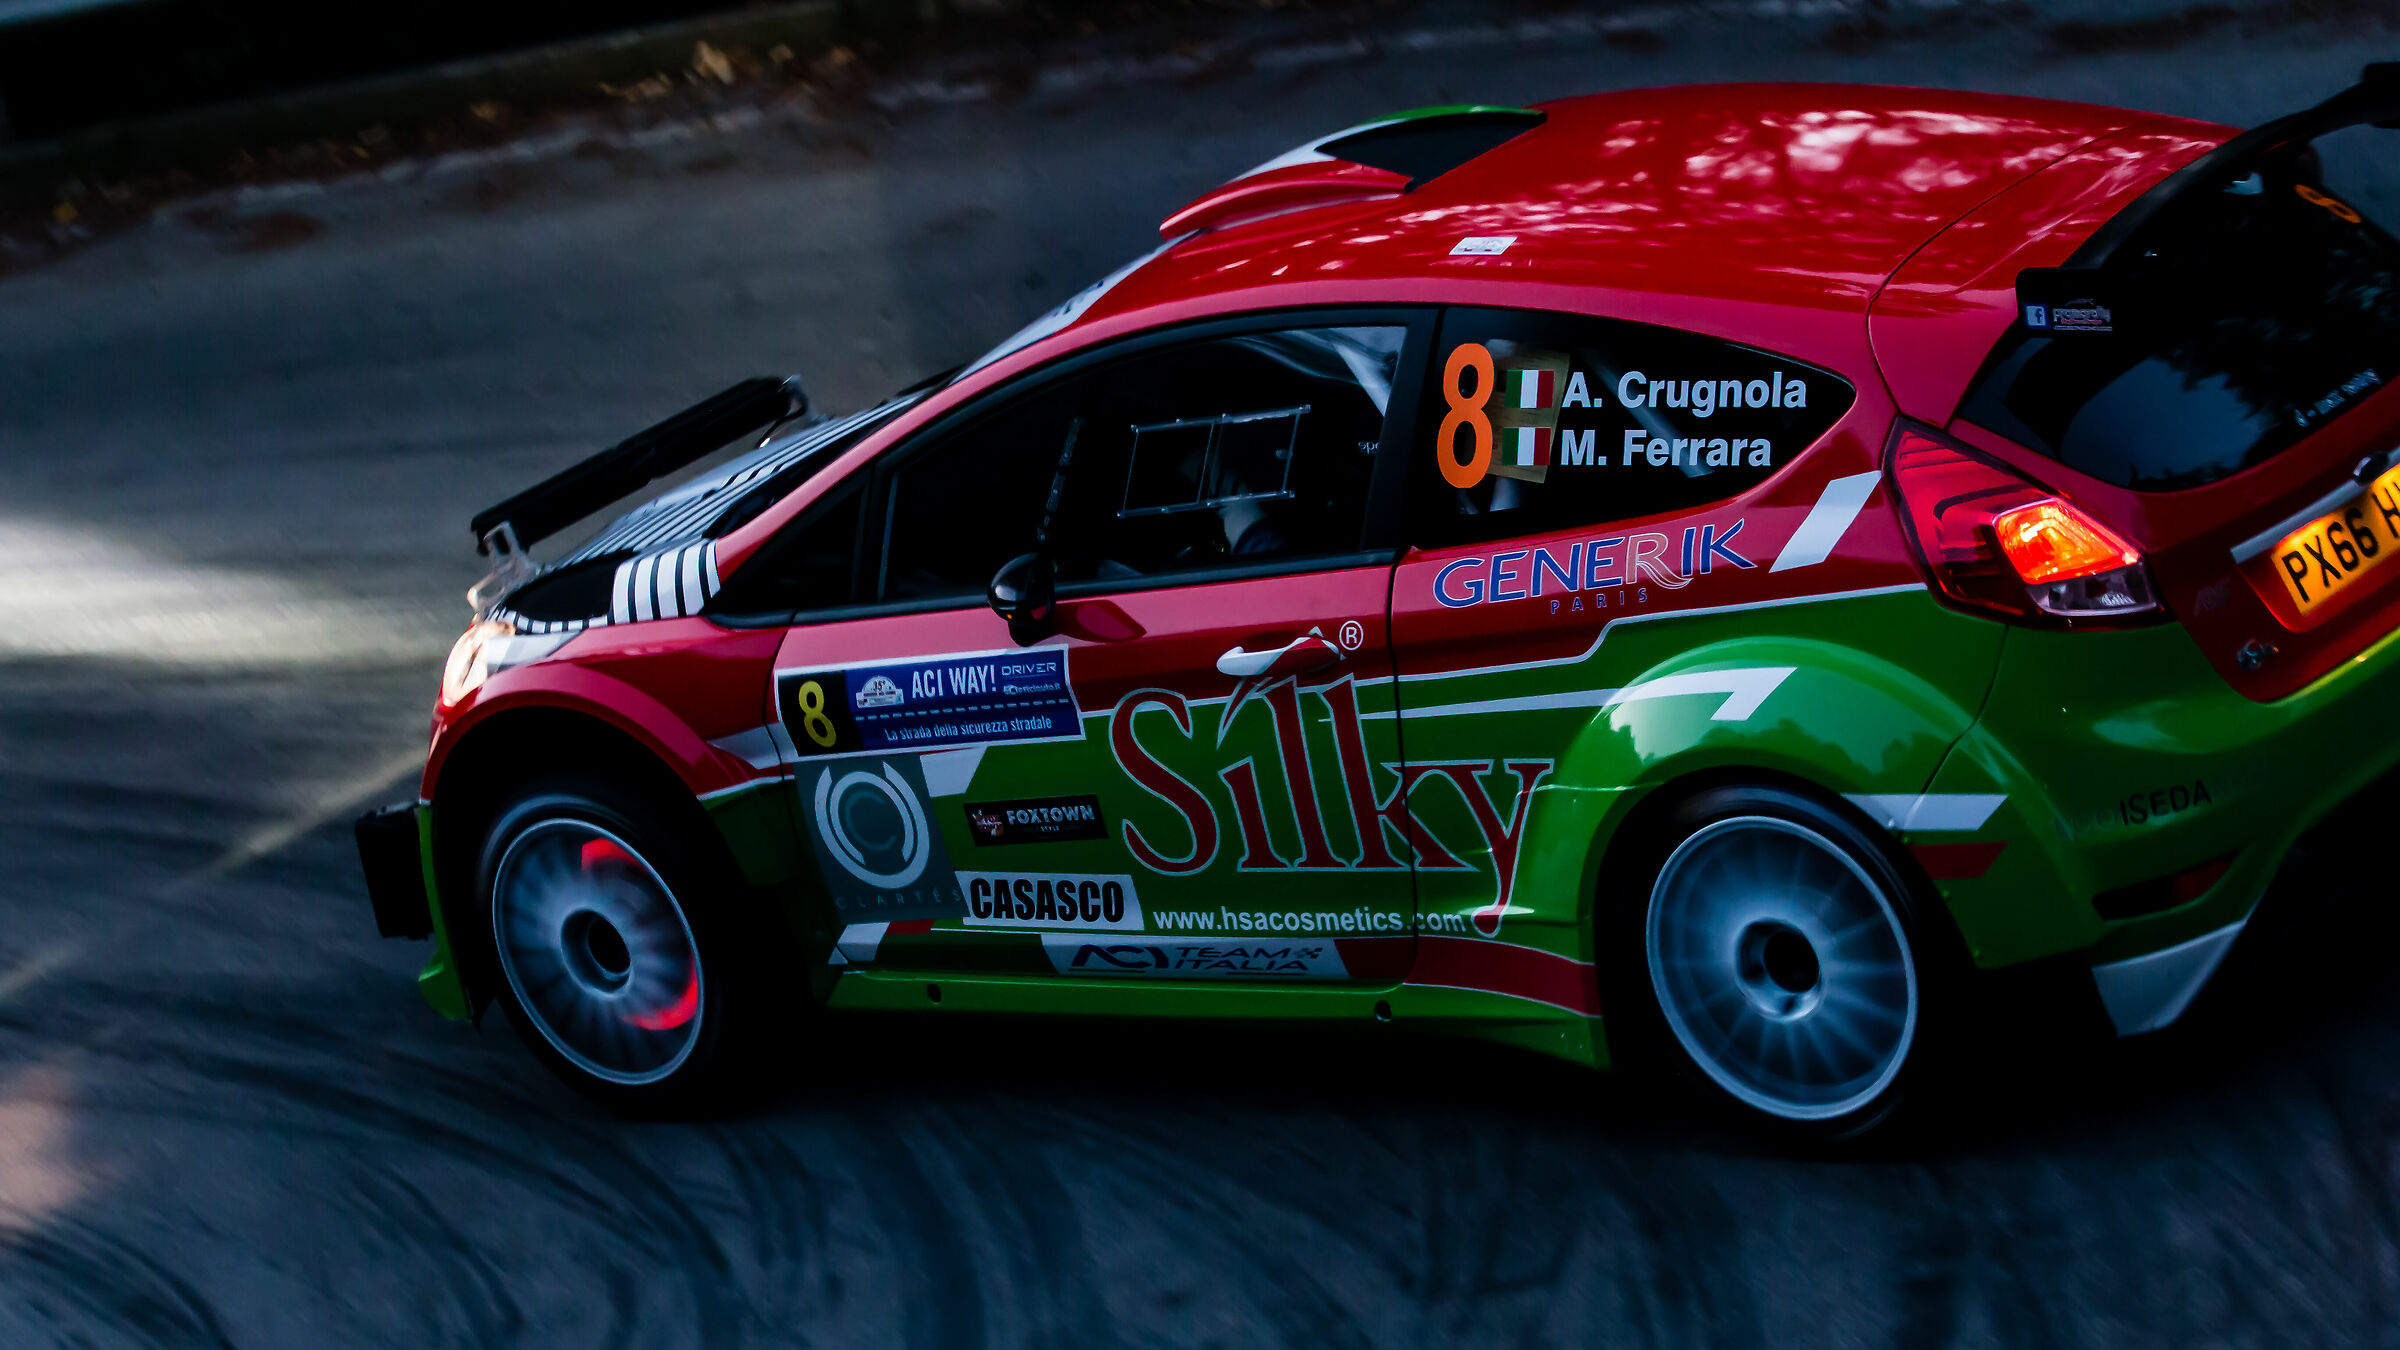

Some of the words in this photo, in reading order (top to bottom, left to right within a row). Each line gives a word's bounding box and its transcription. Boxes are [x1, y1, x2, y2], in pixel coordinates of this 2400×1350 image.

[1561, 371, 1602, 408] A.
[1617, 371, 1808, 418] Crugnola
[1437, 343, 1495, 488] 8
[1561, 429, 1607, 466] M.
[1622, 430, 1771, 466] Ferrara
[2281, 508, 2379, 603] PX66
[2372, 478, 2400, 538] H
[1433, 518, 1758, 608] GENERIK
[1550, 588, 1648, 614] PARIS
[911, 670, 944, 699] ACI
[949, 664, 996, 694] WAY!
[1001, 662, 1057, 676] DRIVER
[799, 681, 837, 748] 8
[900, 726, 932, 741] strada
[934, 722, 959, 737] della
[960, 720, 1009, 736] sicurezza
[1011, 715, 1053, 732] stradale
[1006, 804, 1095, 825] FOXTOWN
[969, 878, 1124, 923] CASASCO
[1153, 906, 1467, 932] www.hsacosmetics.com
[1173, 959, 1309, 971] ITALIA
[1176, 946, 1288, 959] TEAM
